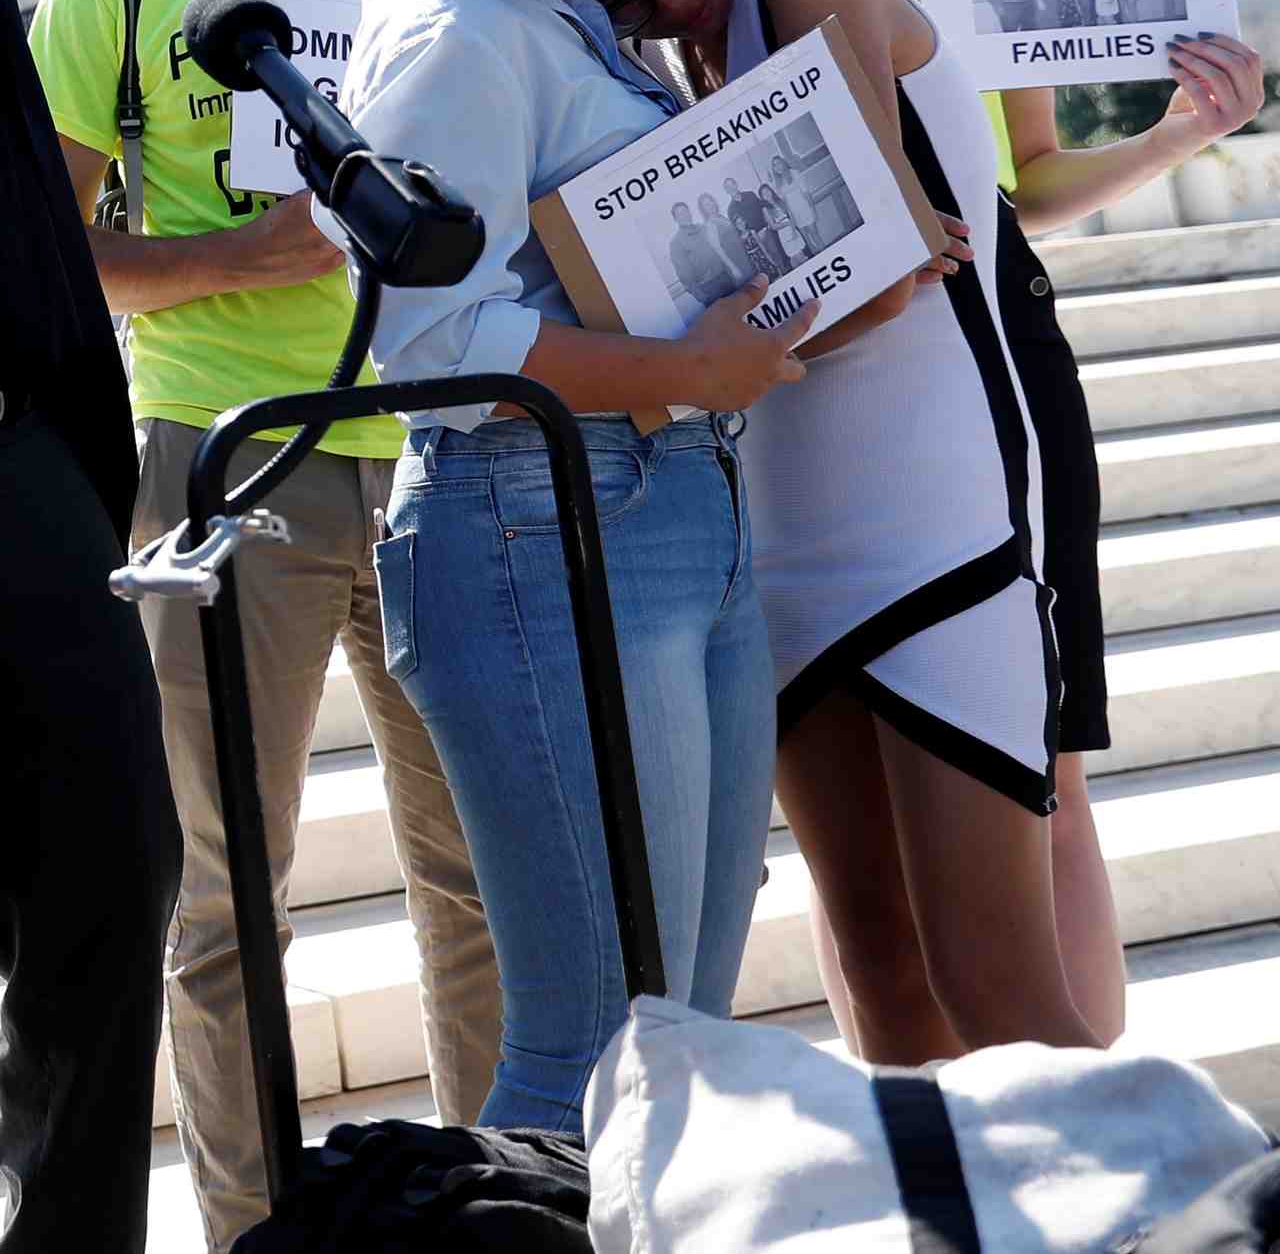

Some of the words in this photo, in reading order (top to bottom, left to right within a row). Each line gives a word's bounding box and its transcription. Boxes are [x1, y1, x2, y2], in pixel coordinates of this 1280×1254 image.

[1013, 34, 1155, 63] FAMILIES
[595, 167, 659, 220] STOP
[664, 91, 789, 179] BREAKING
[790, 66, 822, 99] UP
[744, 256, 851, 330] AMILIES
